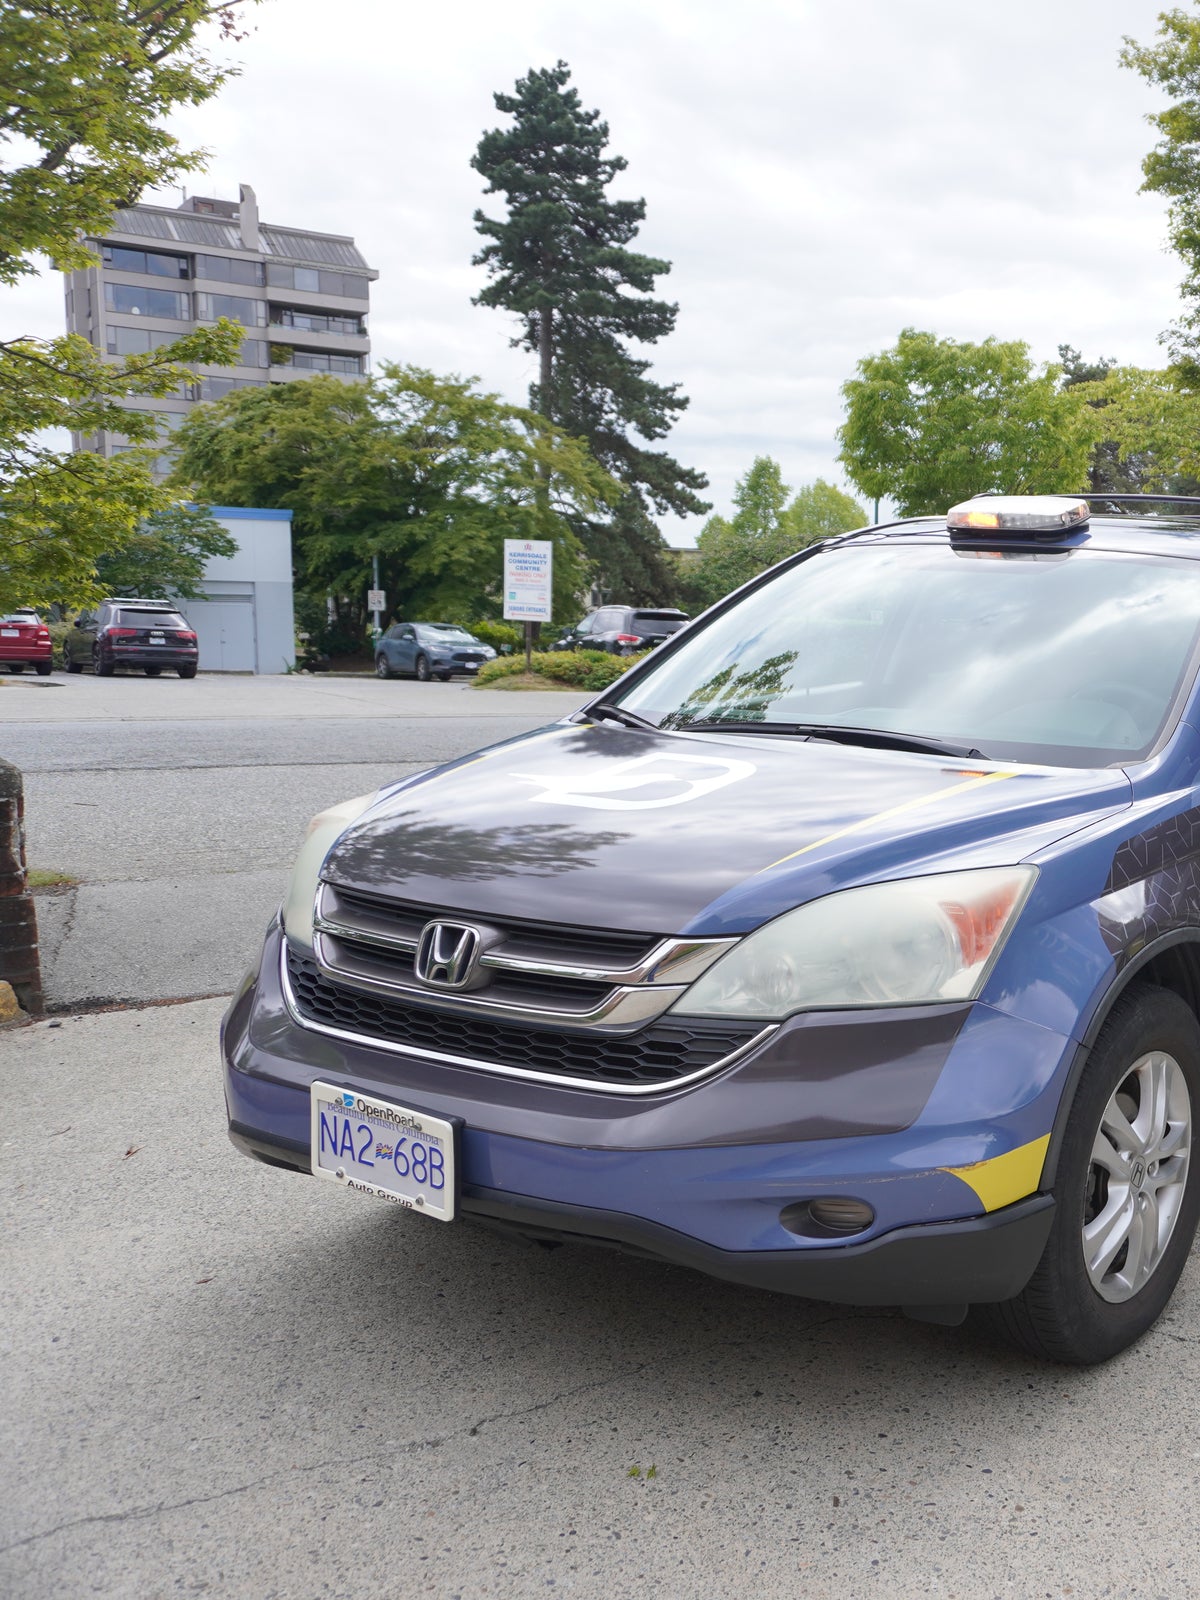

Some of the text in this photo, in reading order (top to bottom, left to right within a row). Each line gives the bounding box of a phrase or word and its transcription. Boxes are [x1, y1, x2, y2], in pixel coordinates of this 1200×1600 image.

[357, 1099, 414, 1128] OpenRoad
[321, 1111, 445, 1190] NA2 68B
[348, 1180, 413, 1208] Auto Group
